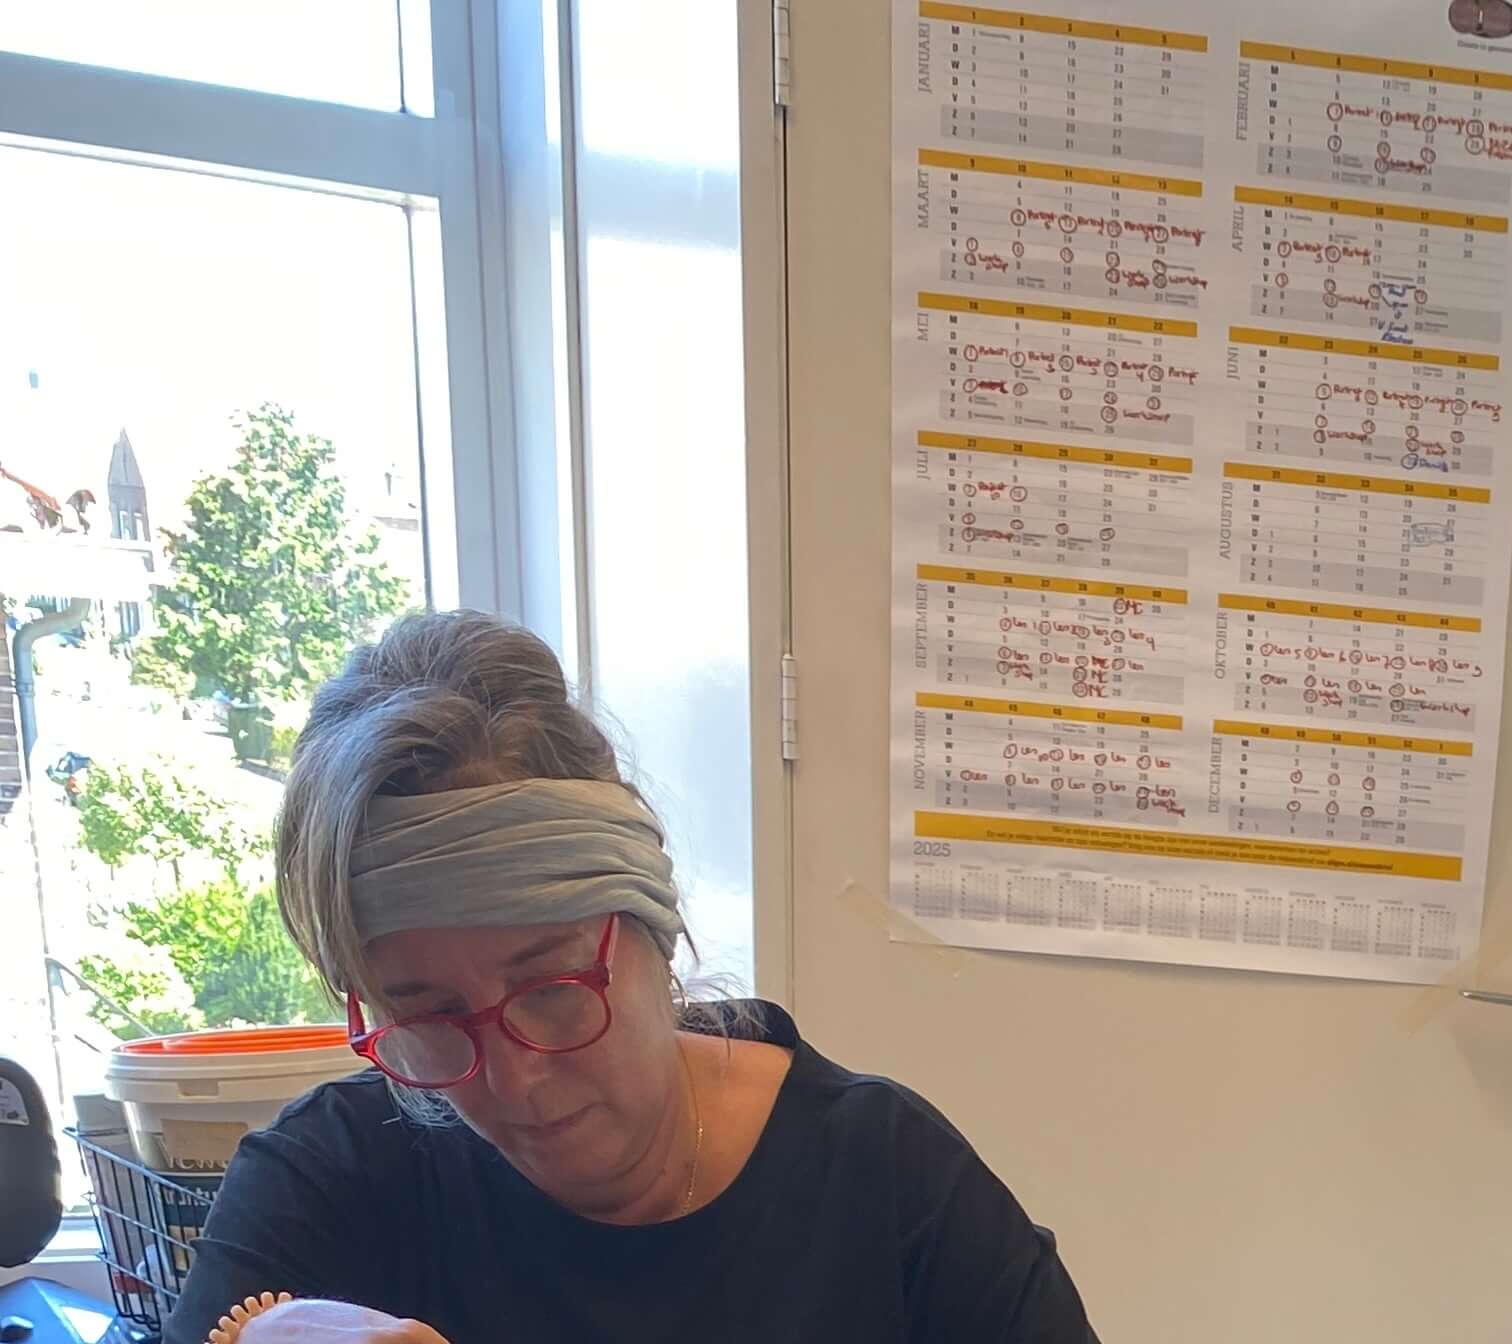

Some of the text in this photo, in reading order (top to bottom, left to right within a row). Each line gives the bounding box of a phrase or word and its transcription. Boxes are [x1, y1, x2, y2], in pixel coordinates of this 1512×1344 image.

[918, 23, 932, 94] JANUARI
[1236, 62, 1250, 141] FEBRUARI
[917, 168, 929, 229] MAART
[1231, 206, 1245, 251] APRIL
[917, 312, 929, 341] MEI
[1226, 347, 1239, 379] JUNI
[917, 450, 929, 479] JULI
[1219, 482, 1233, 559] AUGUSTUS
[916, 583, 928, 668] SEPTEMBER
[1214, 611, 1228, 679] OKTOBER
[914, 710, 927, 790] NOVEMBER
[1208, 737, 1222, 813] DECEMBER
[913, 841, 951, 857] 2025
